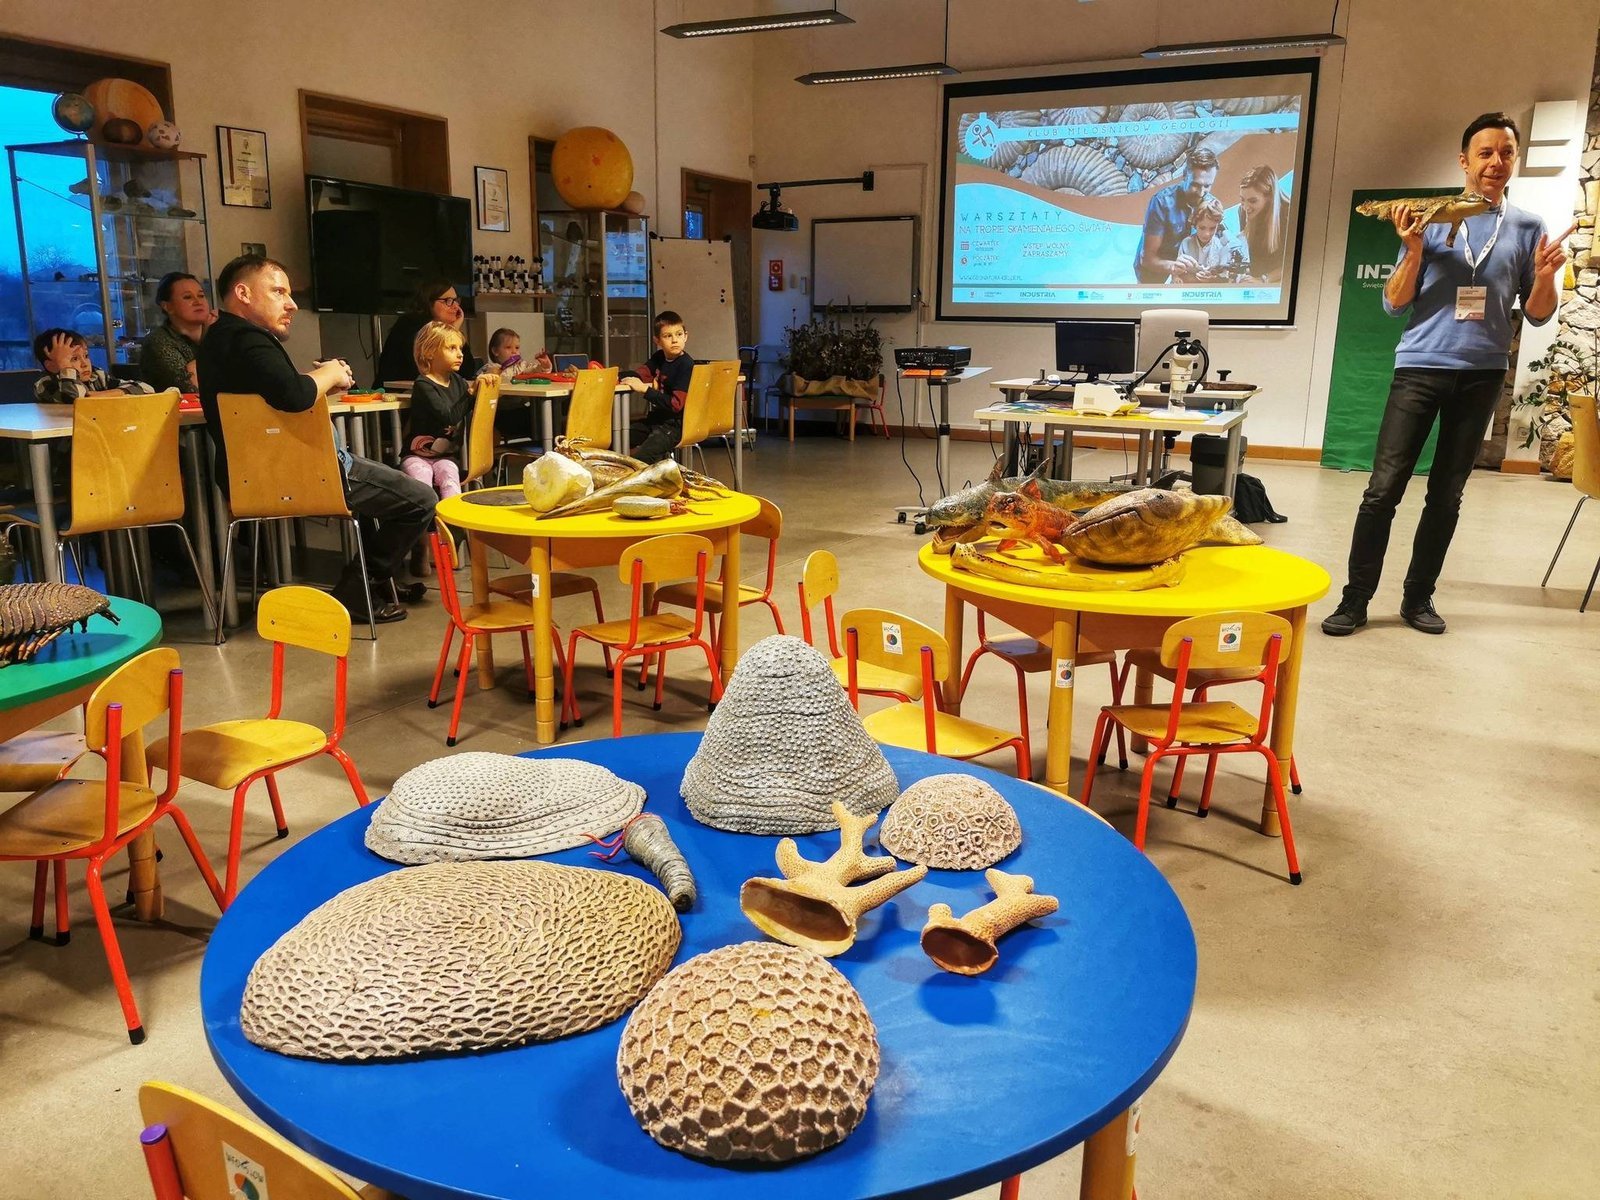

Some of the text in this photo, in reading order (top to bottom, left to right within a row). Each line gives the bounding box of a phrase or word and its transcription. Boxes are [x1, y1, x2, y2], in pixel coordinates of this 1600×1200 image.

[1027, 128, 1058, 137] KLUB
[1161, 119, 1230, 131] GEOLOGII
[960, 211, 1062, 222] WARSZTATY
[959, 225, 971, 234] NA
[975, 224, 1005, 234] TROPIE
[1022, 250, 1069, 258] ZAPRASZAMY
[1181, 290, 1223, 299] INDUSTRIA
